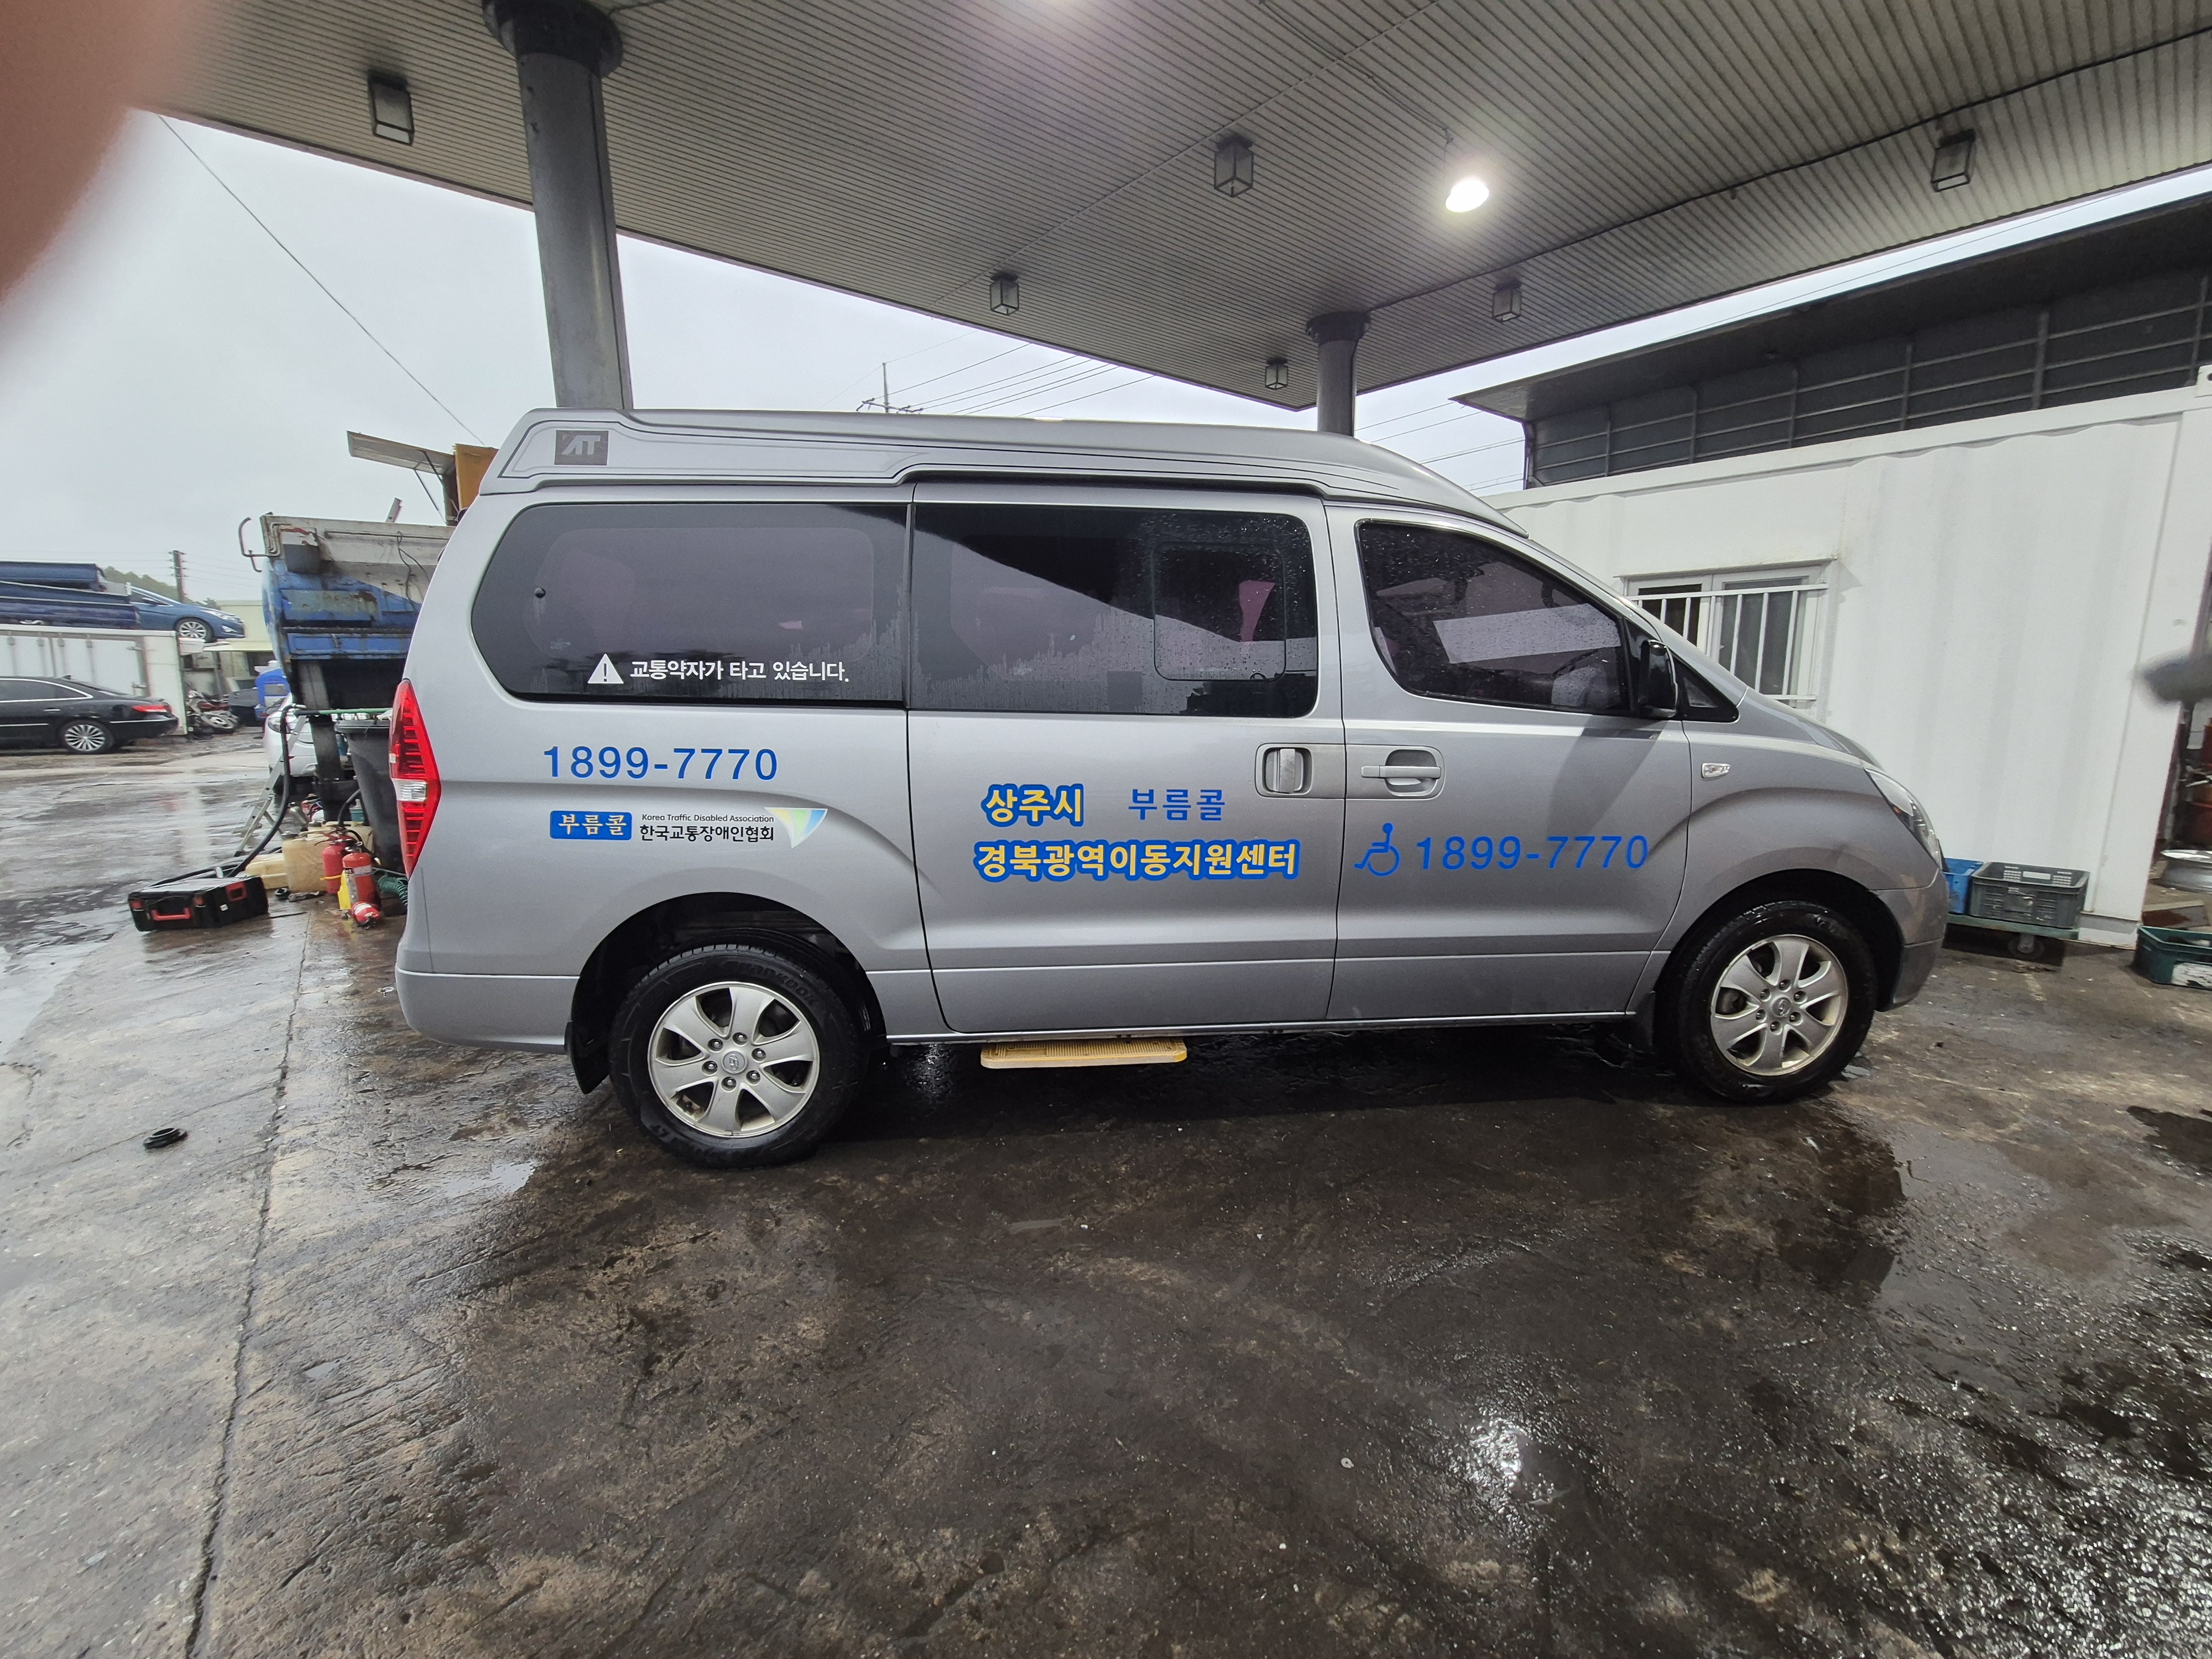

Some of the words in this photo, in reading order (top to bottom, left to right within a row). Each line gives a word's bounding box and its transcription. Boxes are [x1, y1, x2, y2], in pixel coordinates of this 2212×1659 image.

[629, 660, 723, 680] 교통약자가
[729, 660, 766, 680] 타고
[773, 661, 849, 682] 있습니다.
[543, 745, 778, 781] 1899-7770
[667, 813, 692, 822] Traffic
[983, 786, 1083, 825] 상주시
[1128, 789, 1226, 821] 부름콜
[557, 813, 627, 836] 부름콜
[640, 825, 774, 842] 한국교통장애인협회
[975, 841, 1298, 879] 경북광역이동지원센터
[1416, 835, 1649, 870] 1899-7770
